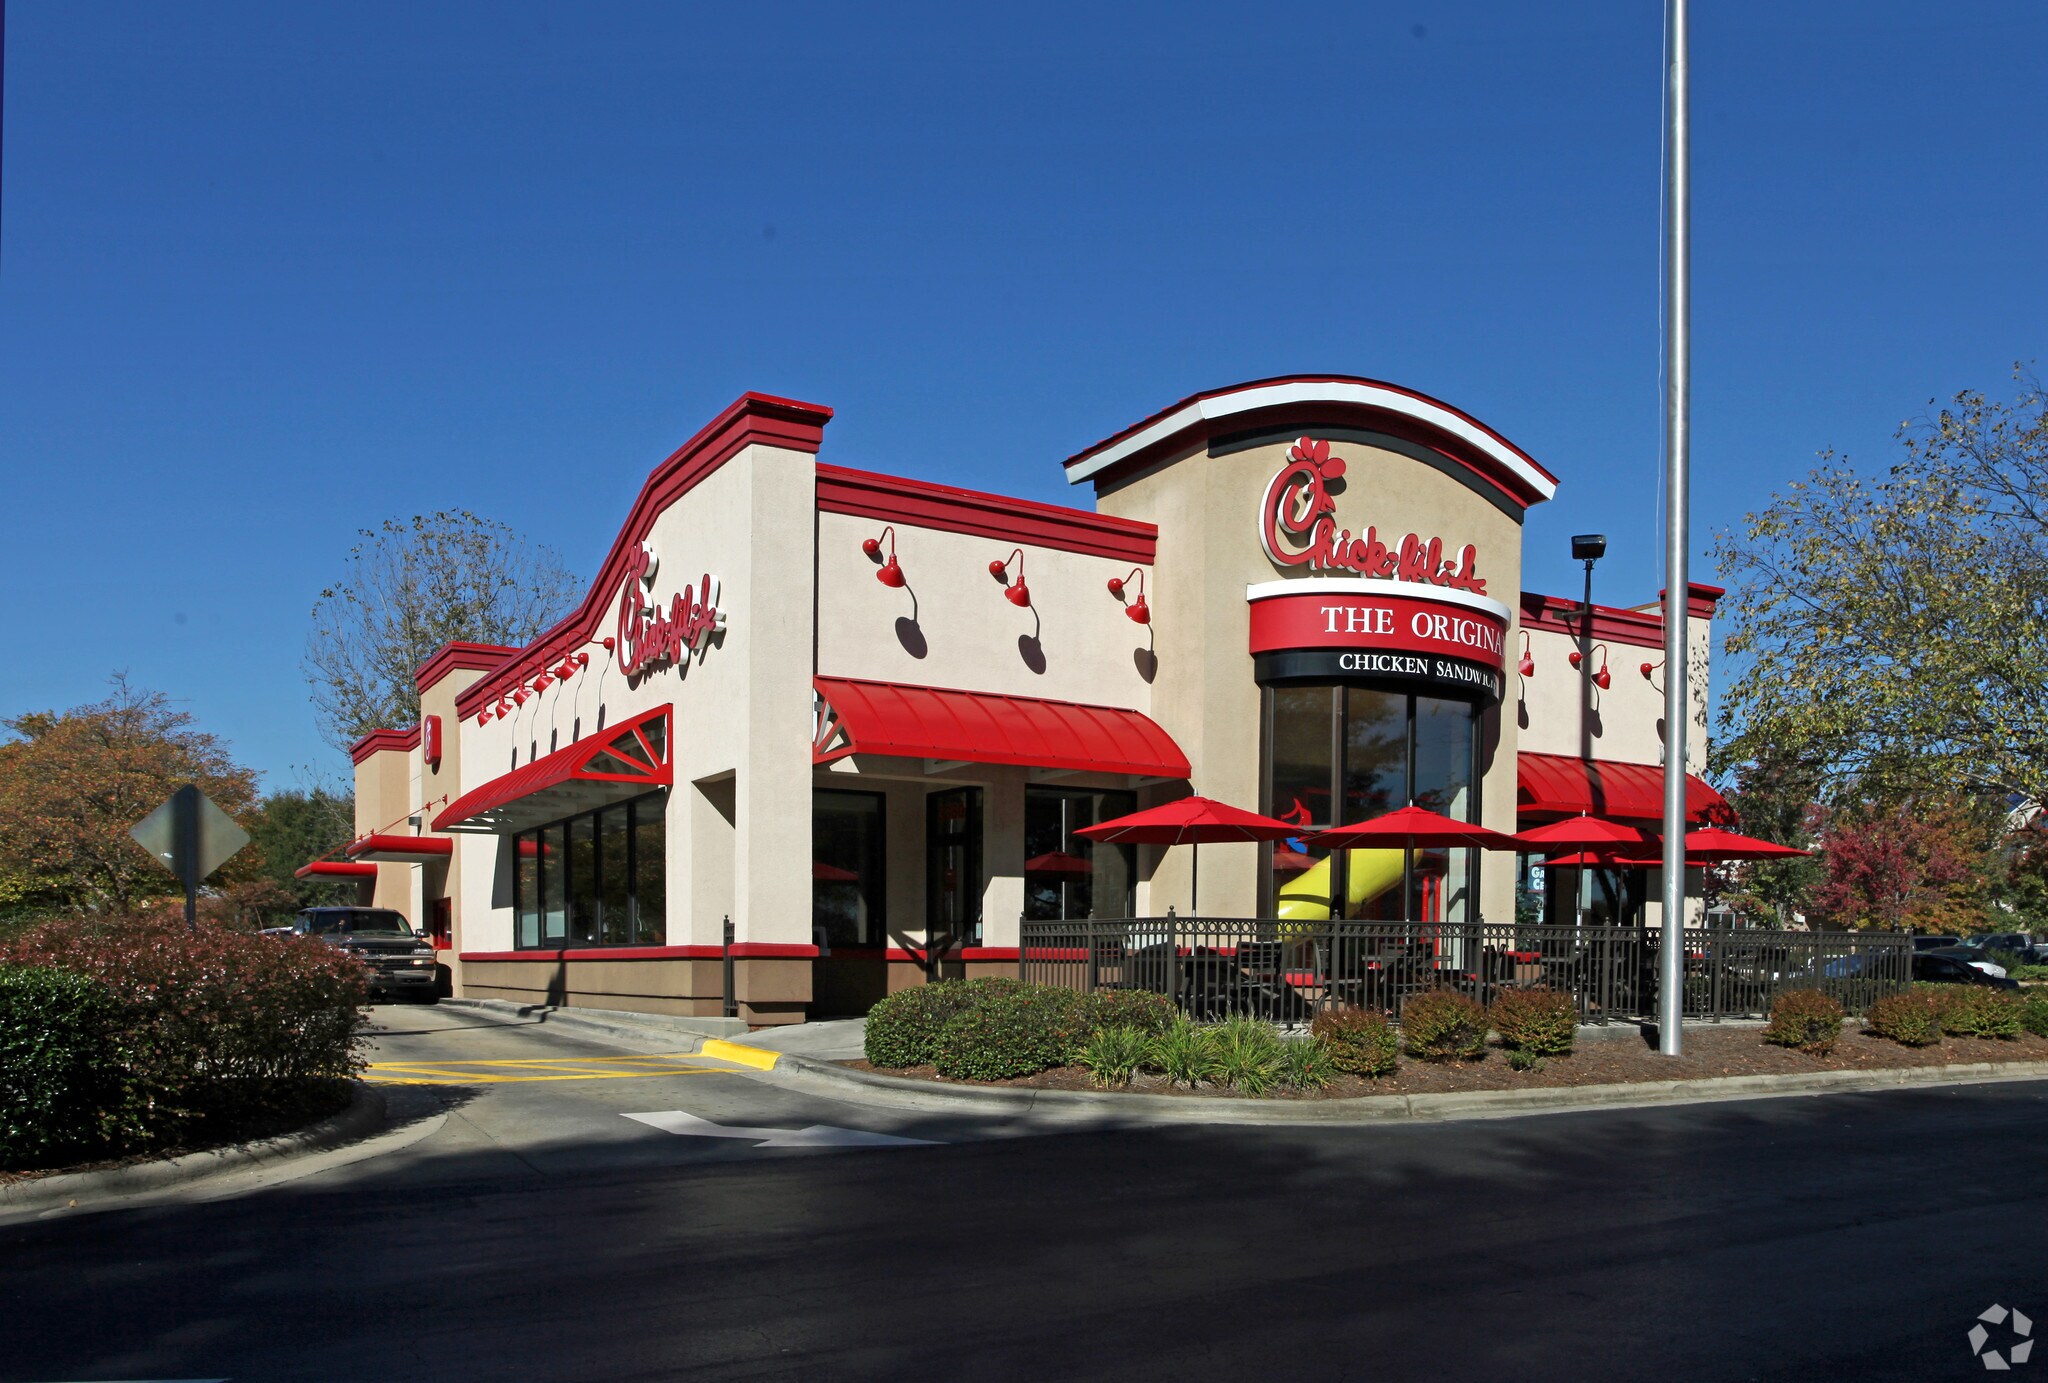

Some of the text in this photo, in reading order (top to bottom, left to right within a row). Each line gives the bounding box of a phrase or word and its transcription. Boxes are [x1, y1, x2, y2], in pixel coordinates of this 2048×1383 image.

[1259, 436, 1488, 597] Chick-fil-A
[1321, 606, 1505, 657] THE ORIGINA
[1339, 653, 1429, 675] CHICKEN
